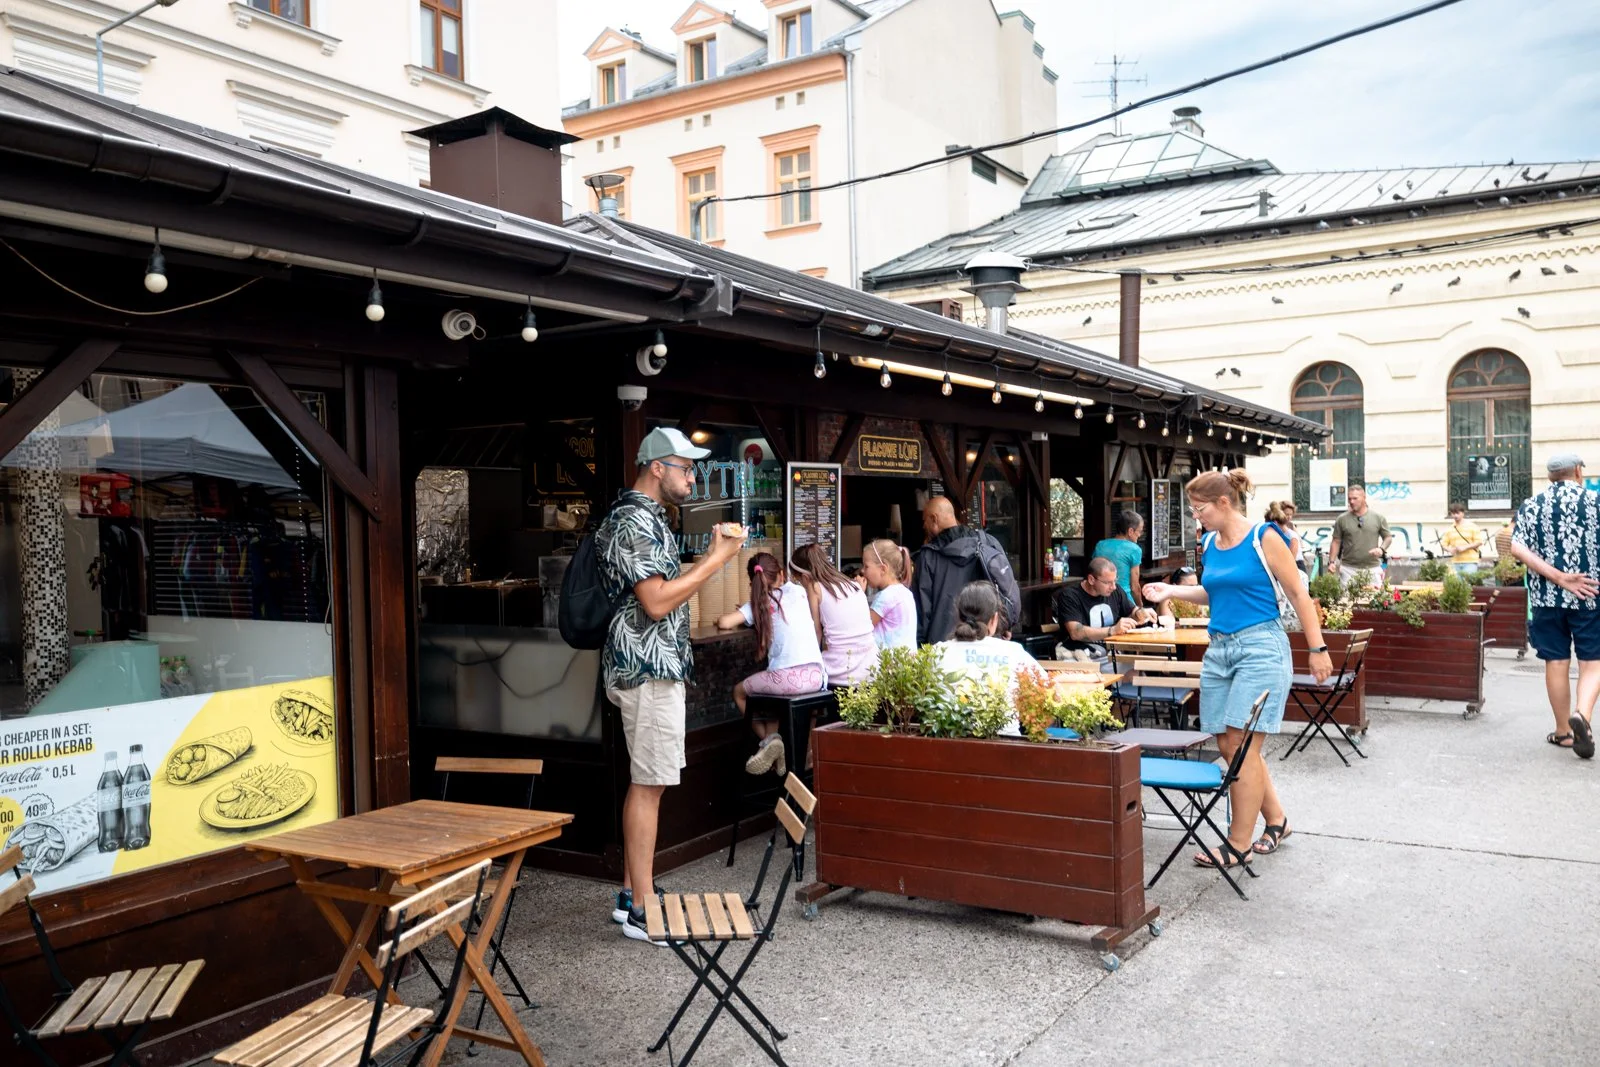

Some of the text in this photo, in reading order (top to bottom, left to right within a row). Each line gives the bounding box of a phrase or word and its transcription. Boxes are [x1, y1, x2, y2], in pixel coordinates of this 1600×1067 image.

[898, 441, 918, 461] LOVE
[4, 723, 92, 746] CHEAPER IN A SET:
[0, 737, 93, 765] R ROLLO KEBAB
[52, 765, 68, 779] 0,5
[71, 764, 76, 776] L
[3, 824, 14, 834] pln
